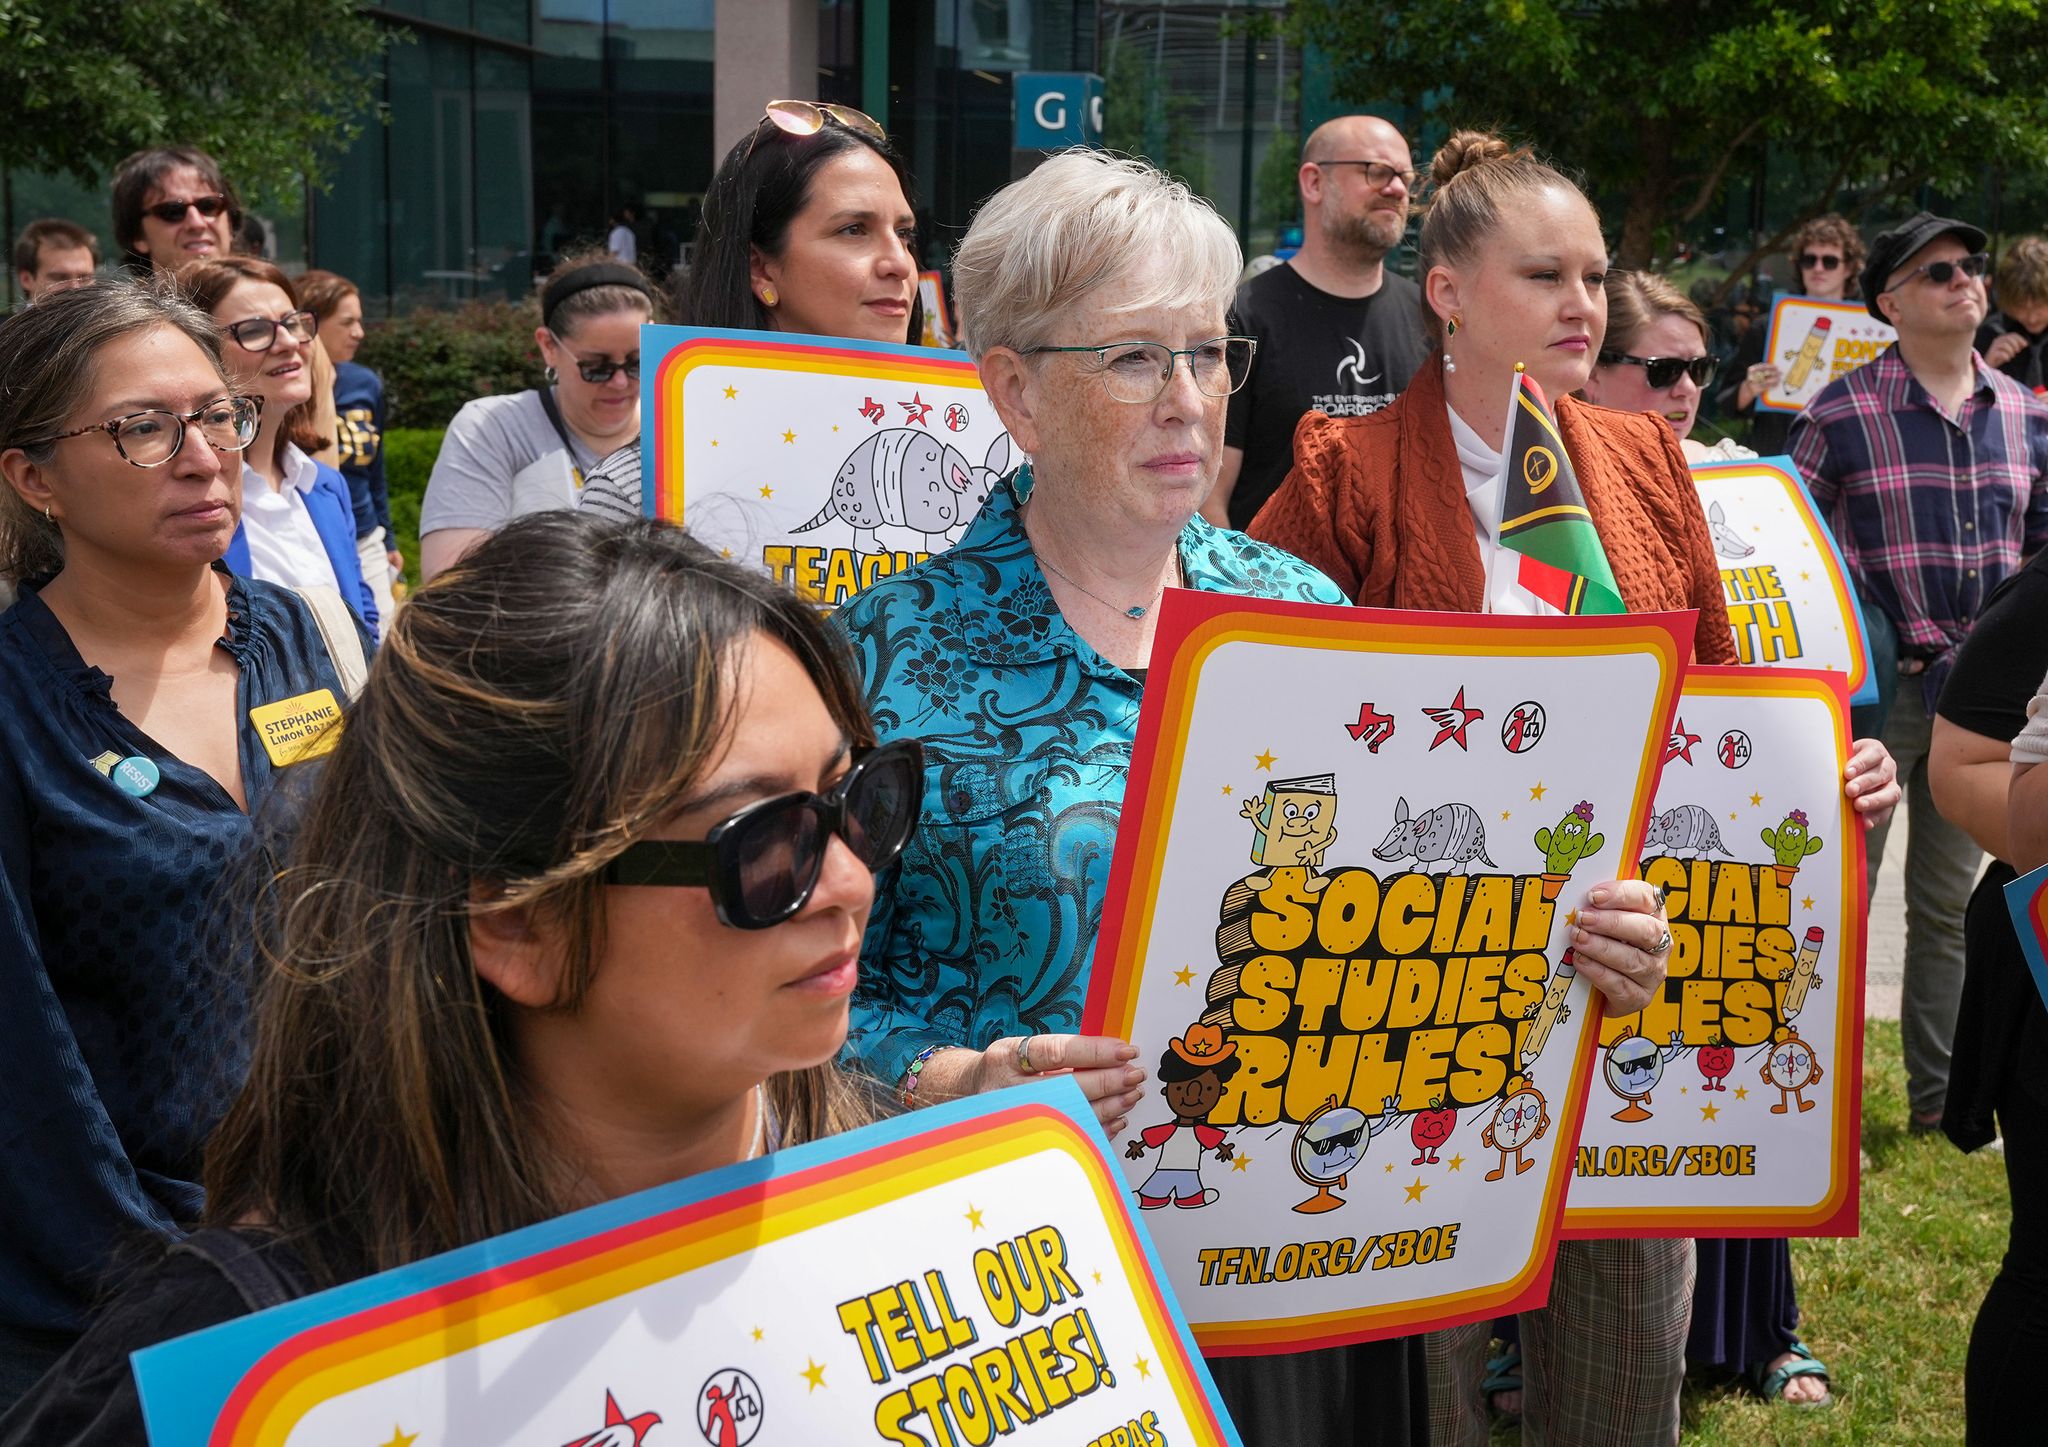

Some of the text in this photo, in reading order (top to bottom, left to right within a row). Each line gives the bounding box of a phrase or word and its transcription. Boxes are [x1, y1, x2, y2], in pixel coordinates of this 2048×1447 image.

[1034, 91, 1066, 130] G
[265, 706, 336, 735] STEPHANIE
[119, 761, 155, 792] RESIST
[1248, 868, 1557, 955] SOCIAL
[1231, 953, 1550, 1032] STUDIES
[1206, 1019, 1536, 1126] RULES!
[1574, 1144, 1757, 1178] N.ORG/SBOE
[1198, 1222, 1461, 1286] TFN.ORG/SBOE
[836, 1225, 1083, 1384] TELL OUR
[874, 1307, 1117, 1447] STORIES!
